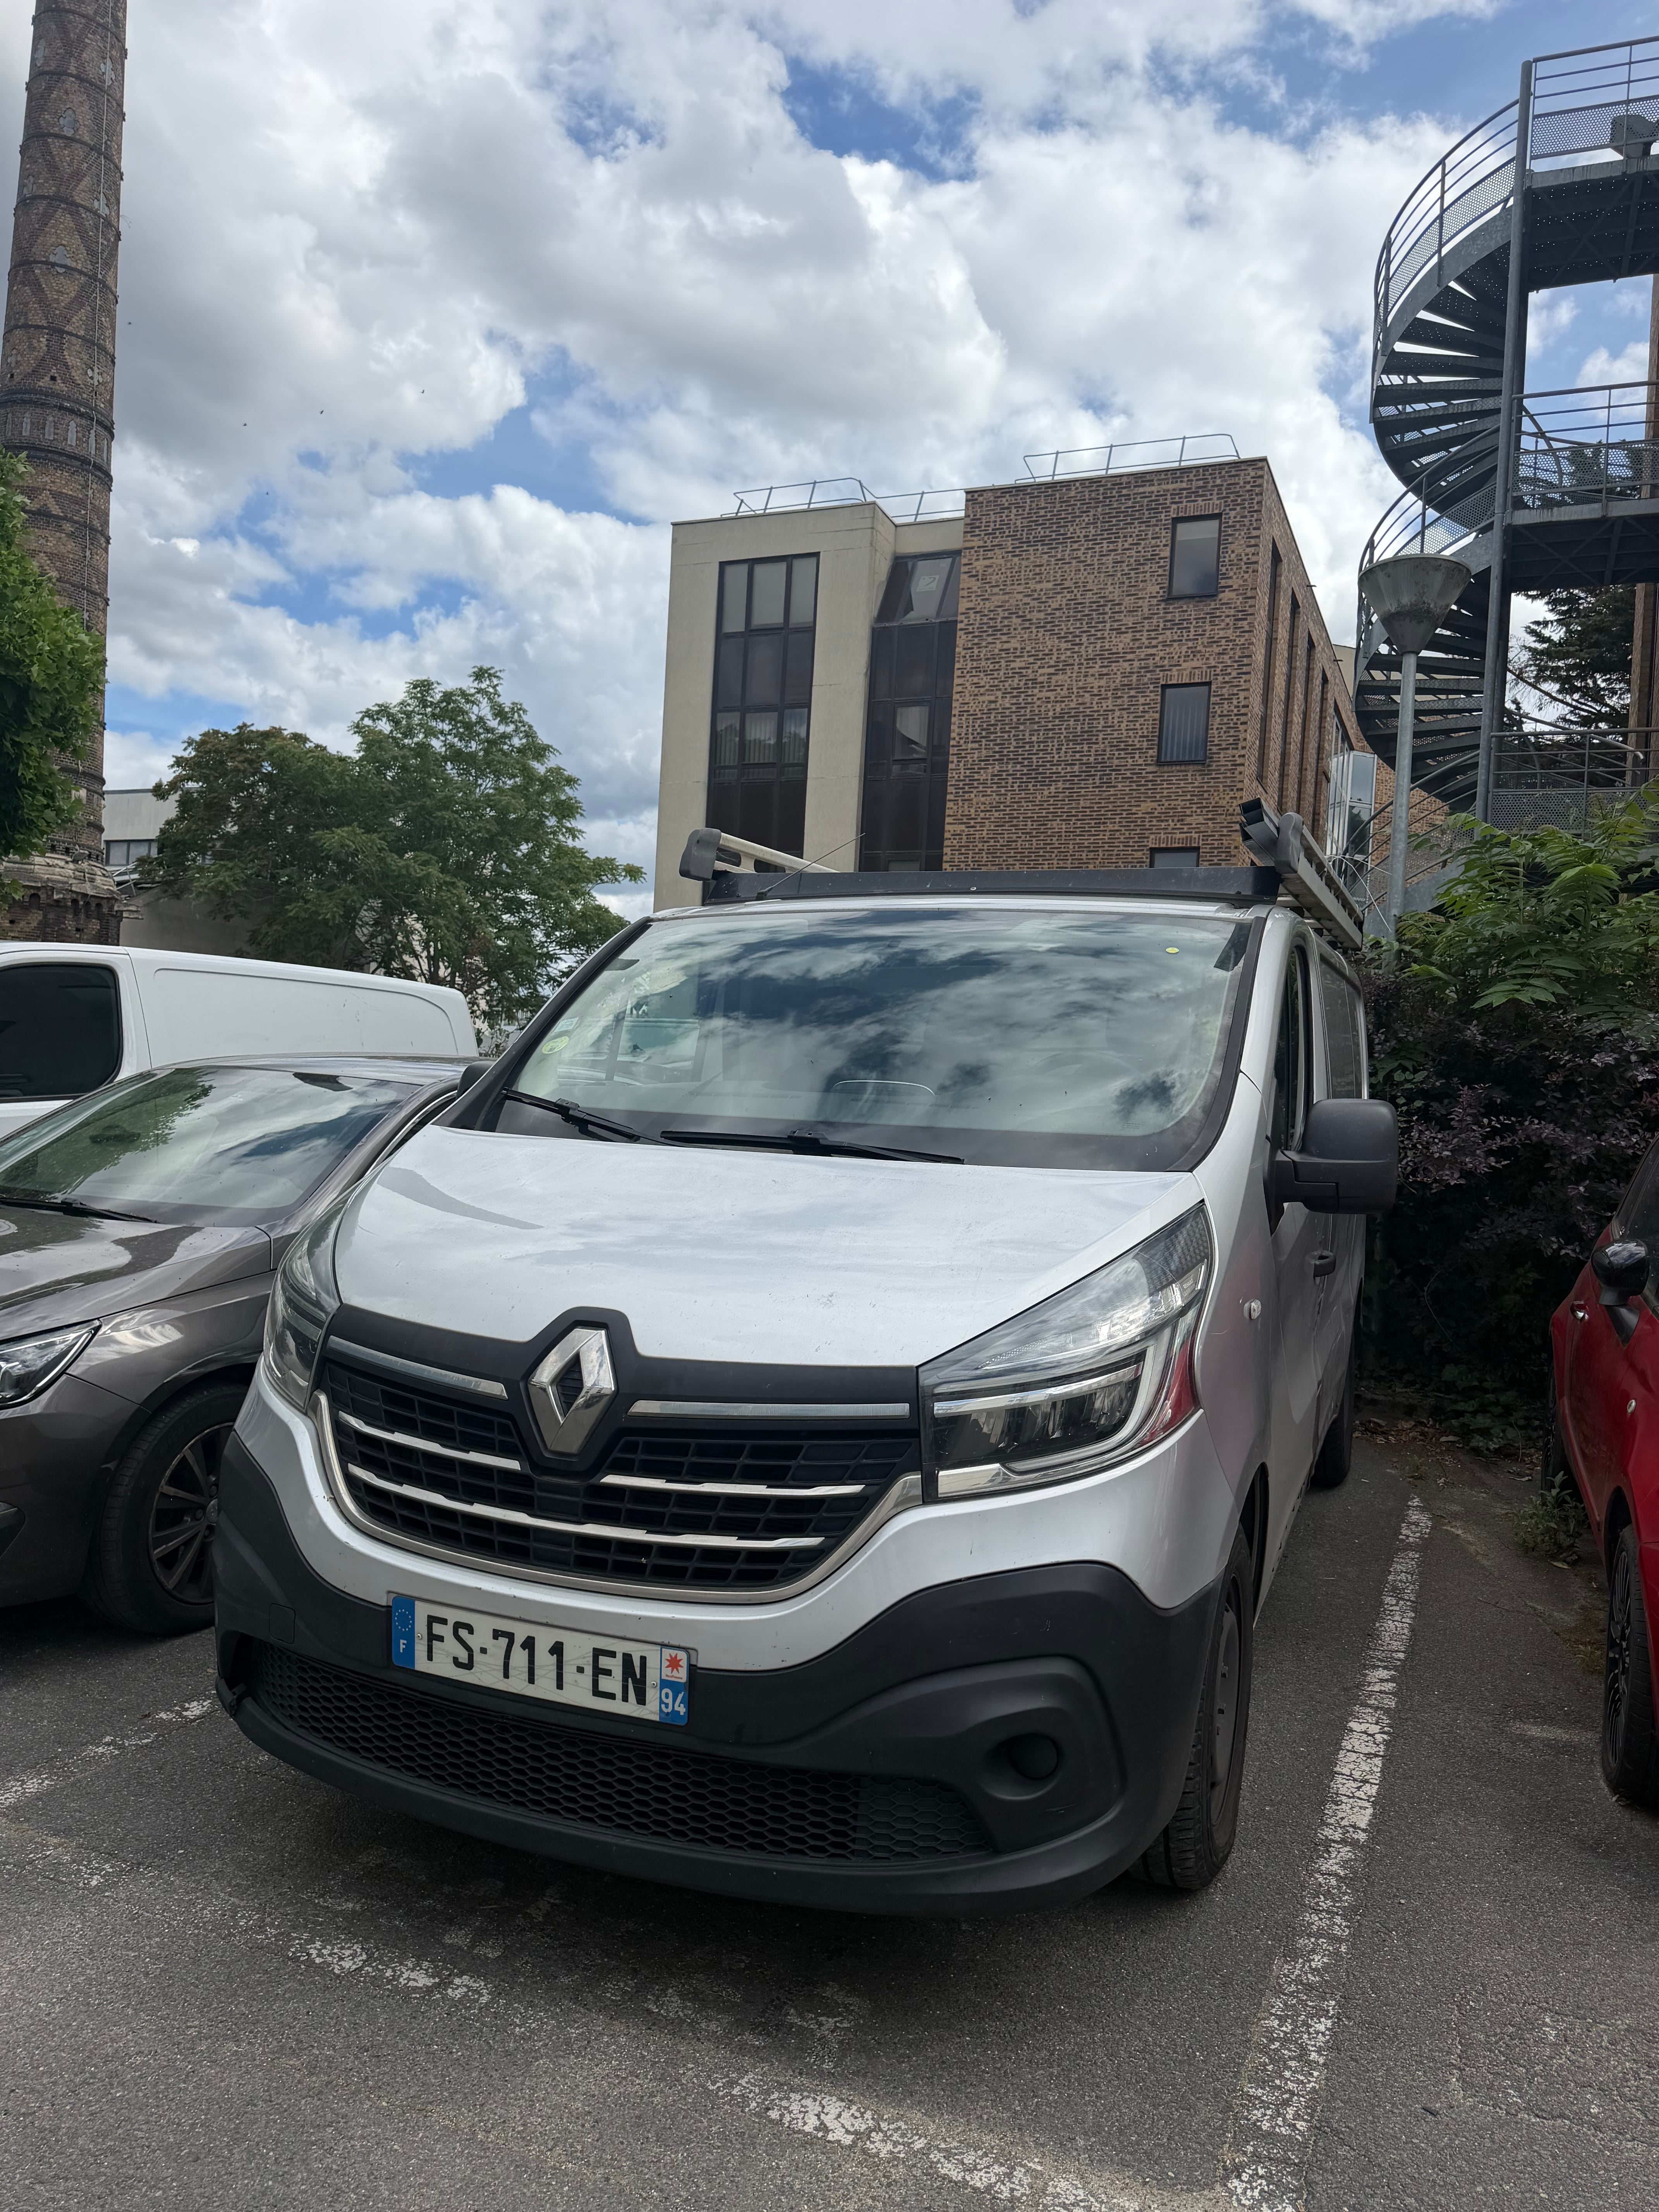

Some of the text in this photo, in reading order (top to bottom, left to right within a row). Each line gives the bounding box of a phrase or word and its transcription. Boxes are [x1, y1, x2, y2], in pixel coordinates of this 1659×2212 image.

[400, 1639, 407, 1653] F
[427, 1614, 646, 1705] FS-711-EN
[661, 1688, 686, 1716] 94
